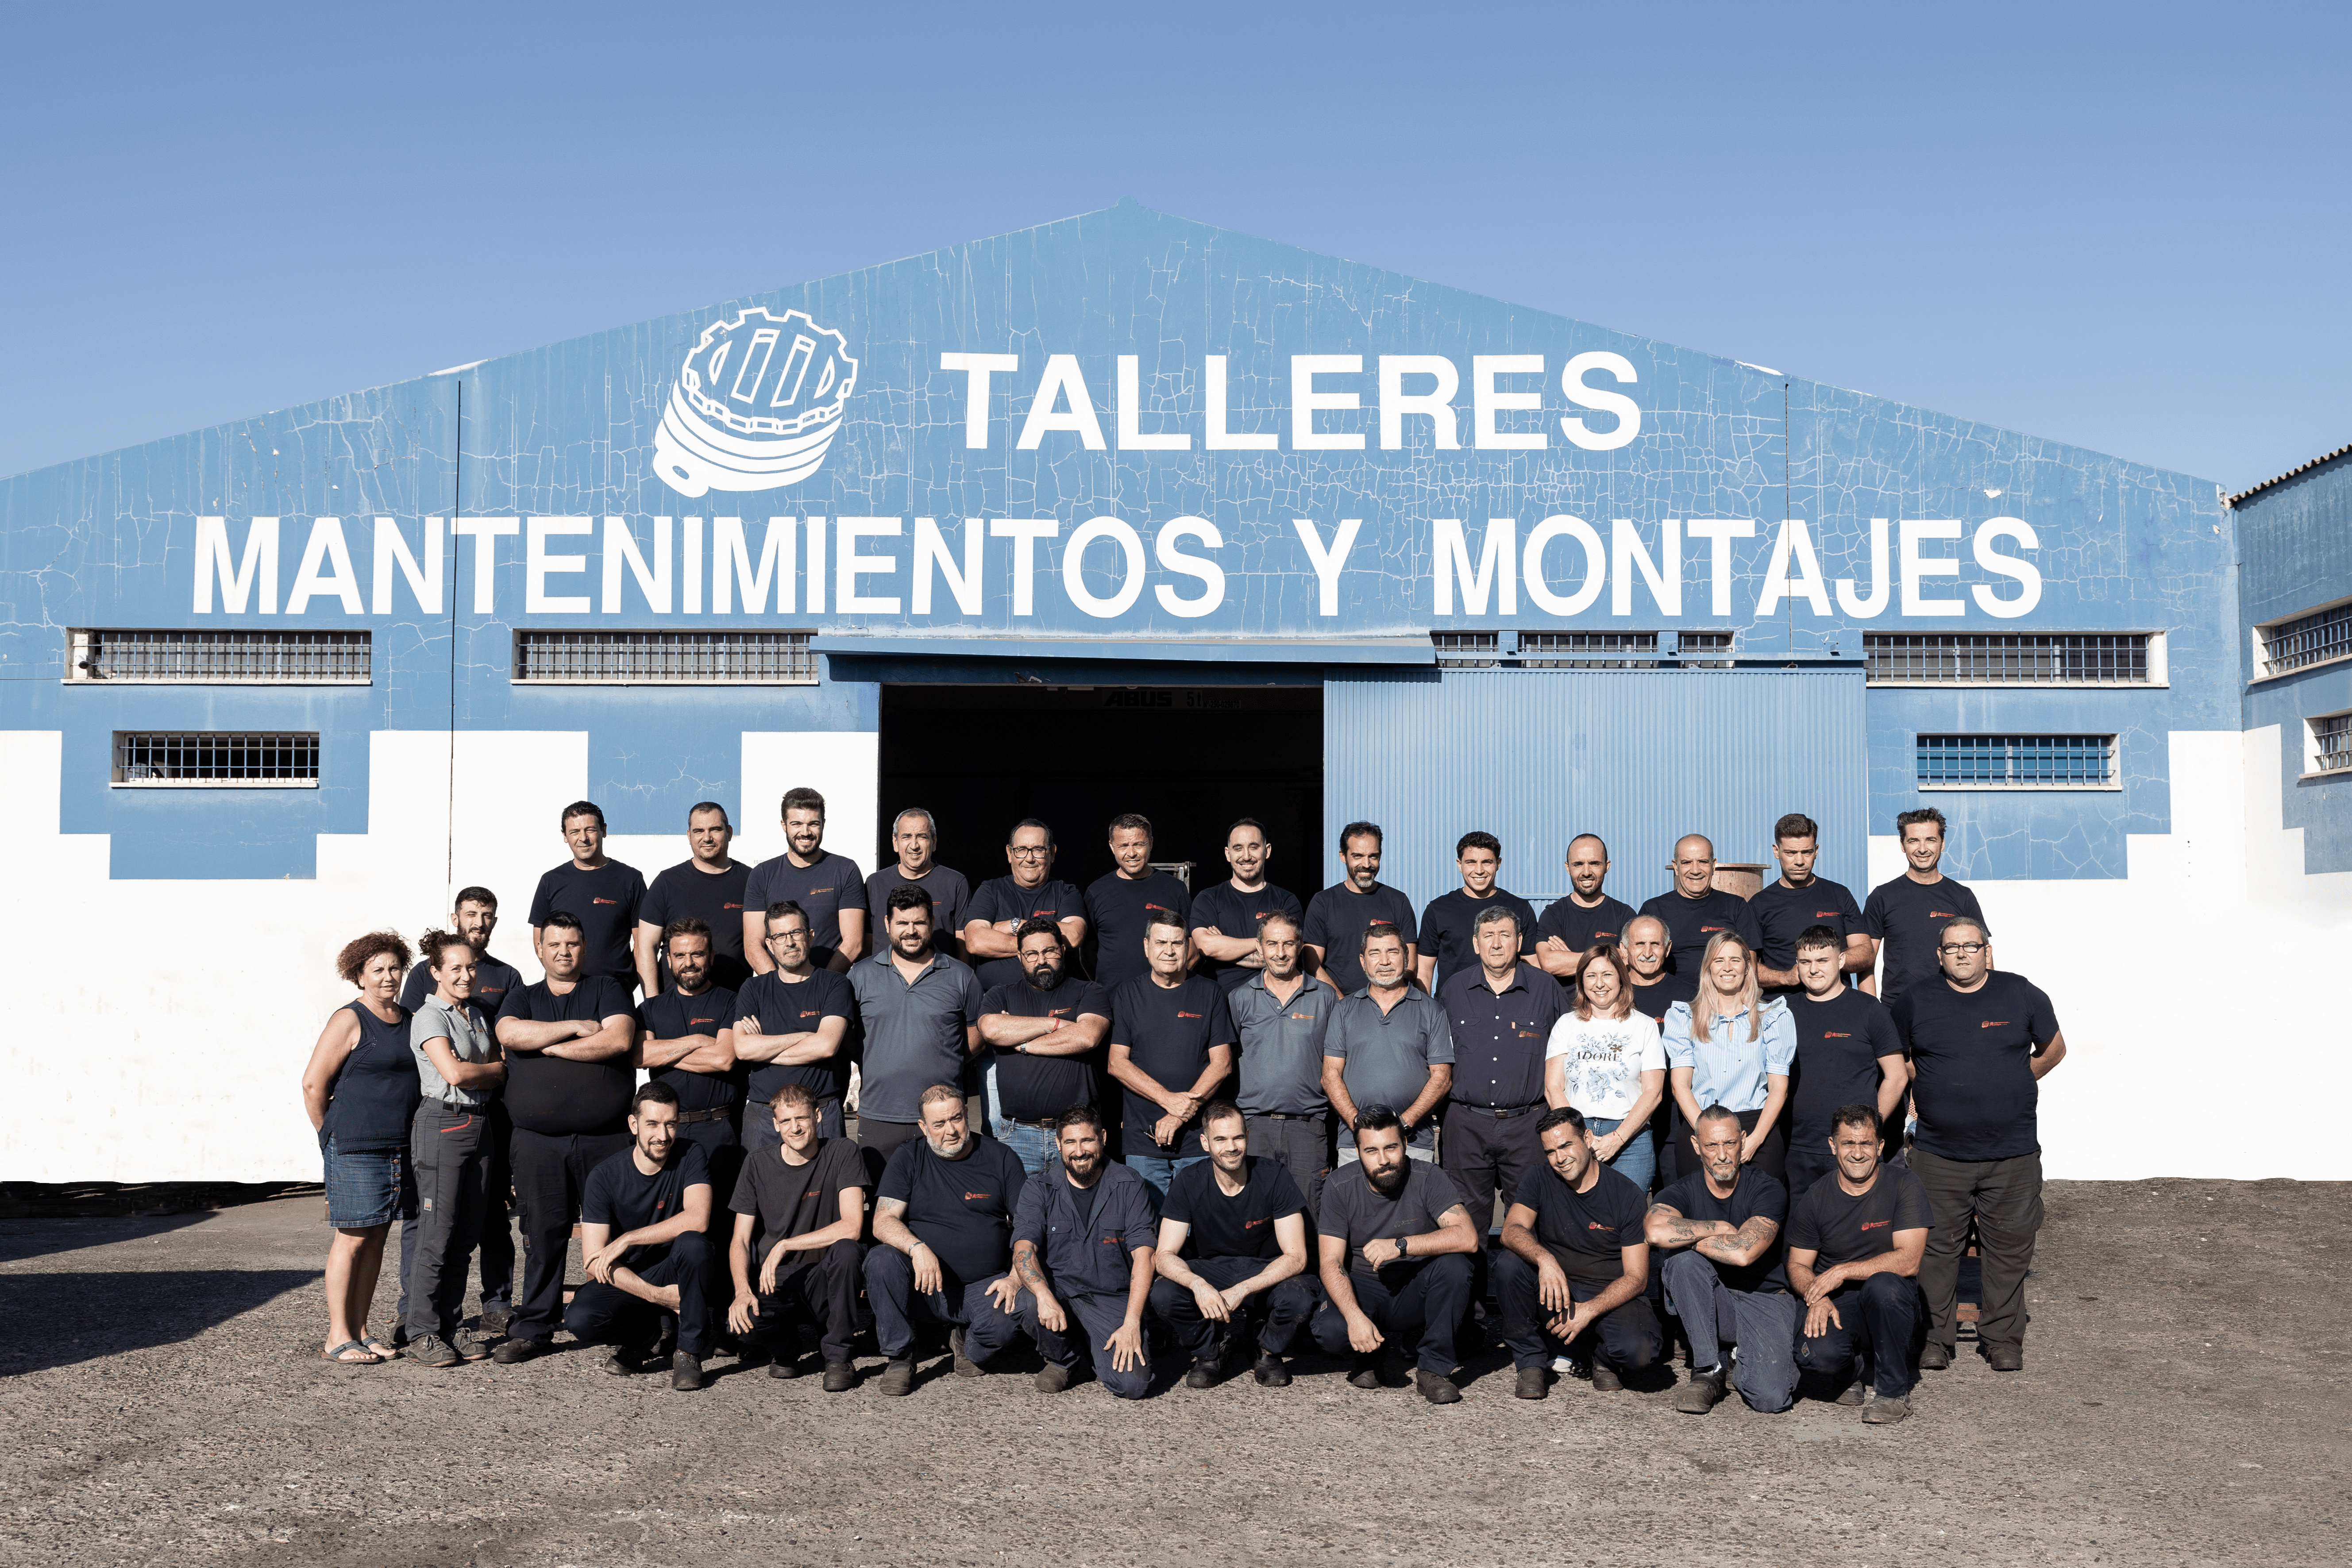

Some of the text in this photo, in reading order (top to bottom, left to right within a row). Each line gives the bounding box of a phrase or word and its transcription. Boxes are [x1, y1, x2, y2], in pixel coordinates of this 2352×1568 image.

[940, 351, 1641, 451] TALLERES
[193, 516, 2042, 619] MANTENIMIENTOS Y MONTAJES
[1103, 691, 1172, 707] ABUS
